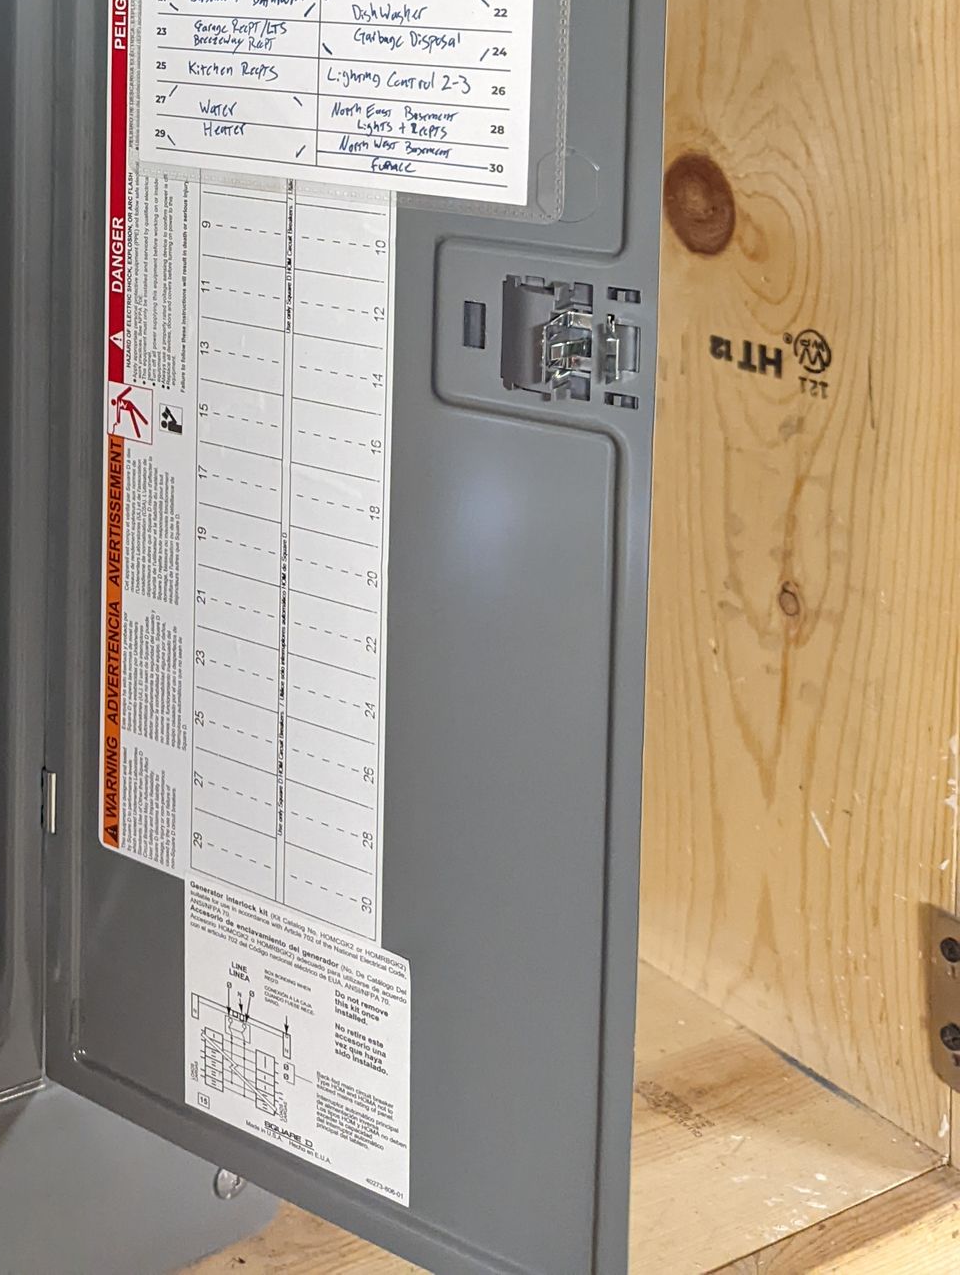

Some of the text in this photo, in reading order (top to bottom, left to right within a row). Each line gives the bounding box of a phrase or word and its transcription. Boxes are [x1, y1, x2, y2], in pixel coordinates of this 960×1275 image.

[493, 9, 507, 17] 22
[156, 28, 167, 36] 23
[492, 48, 507, 57] 24
[156, 61, 167, 70] 25
[188, 60, 233, 76] Kitchen
[491, 86, 506, 96] 26
[155, 95, 166, 103] 27
[154, 129, 165, 138] 29
[490, 125, 504, 134] 28
[489, 164, 504, 173] 30
[112, 217, 124, 293] DANGER
[376, 240, 386, 255] 10
[201, 341, 209, 354] 13
[737, 340, 782, 378] HT
[108, 440, 122, 586] AVERTISSEMENT
[370, 506, 380, 520] 18
[198, 527, 207, 540] 19
[366, 637, 376, 654] 22
[106, 601, 120, 725] ADVERTENCIA
[105, 736, 119, 818] WARNING
[193, 832, 202, 848] 29
[190, 881, 223, 899] Generator
[362, 897, 372, 914] 30
[231, 961, 248, 974] LINE
[229, 968, 250, 983] LINEA
[335, 990, 389, 1017] Do not remove
[264, 1120, 301, 1143] SQUARE
